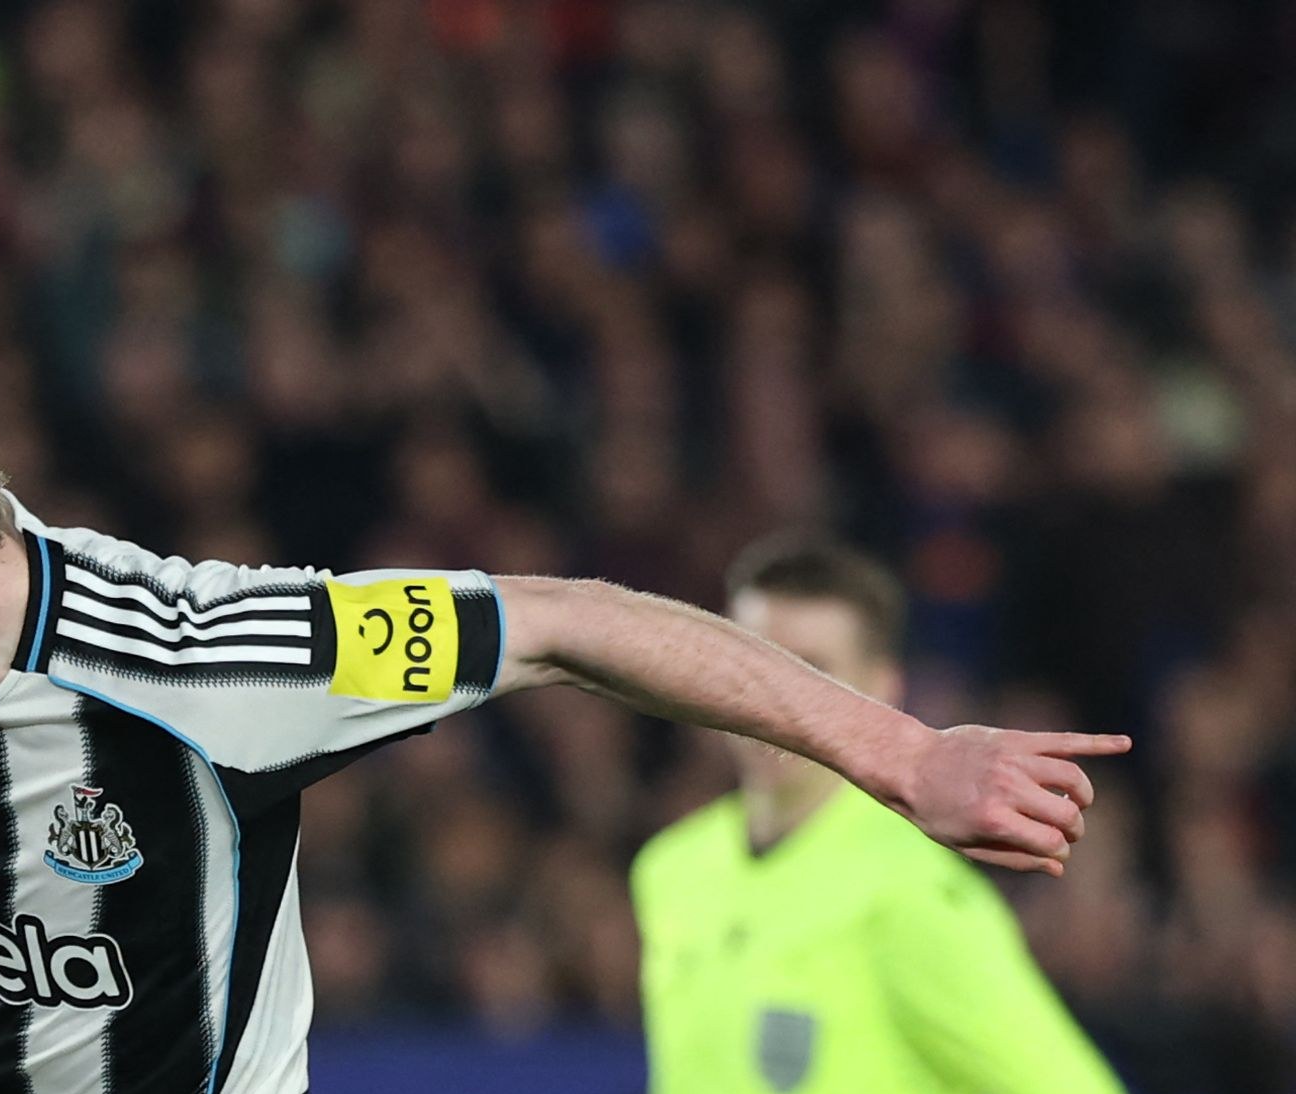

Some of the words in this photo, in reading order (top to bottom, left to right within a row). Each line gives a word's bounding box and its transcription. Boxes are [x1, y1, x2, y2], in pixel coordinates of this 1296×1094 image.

[402, 584, 434, 693] noon
[57, 867, 100, 881] NEWCASTLE
[101, 868, 129, 880] UNITED
